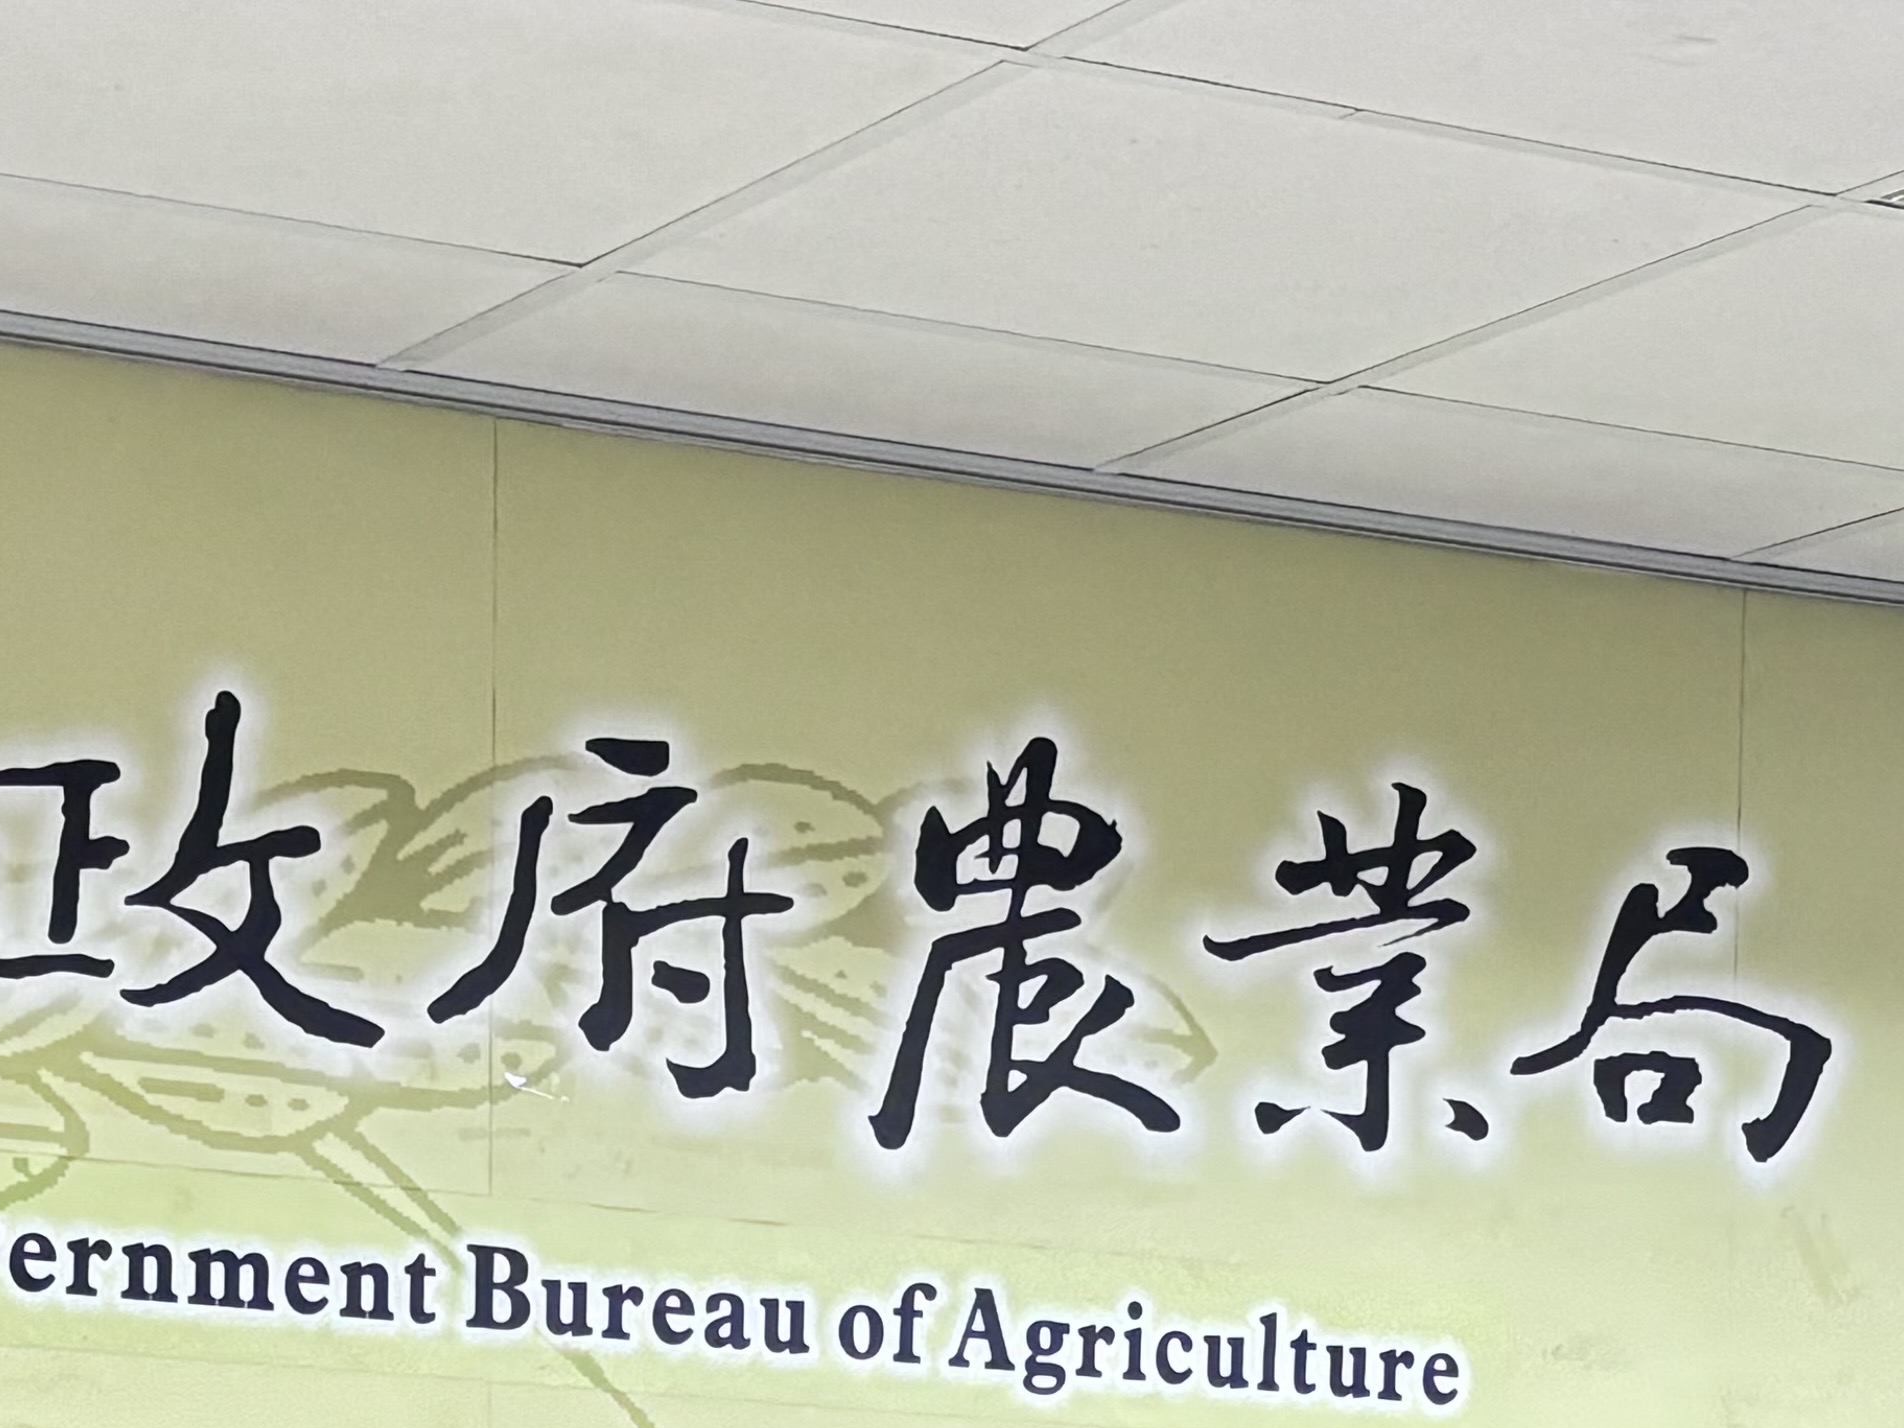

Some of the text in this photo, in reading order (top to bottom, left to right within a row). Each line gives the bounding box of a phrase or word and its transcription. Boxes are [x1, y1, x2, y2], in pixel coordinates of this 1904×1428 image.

[467, 1245, 809, 1353] Bureau
[839, 1283, 936, 1362] of
[961, 1289, 1457, 1404] Agriculture
